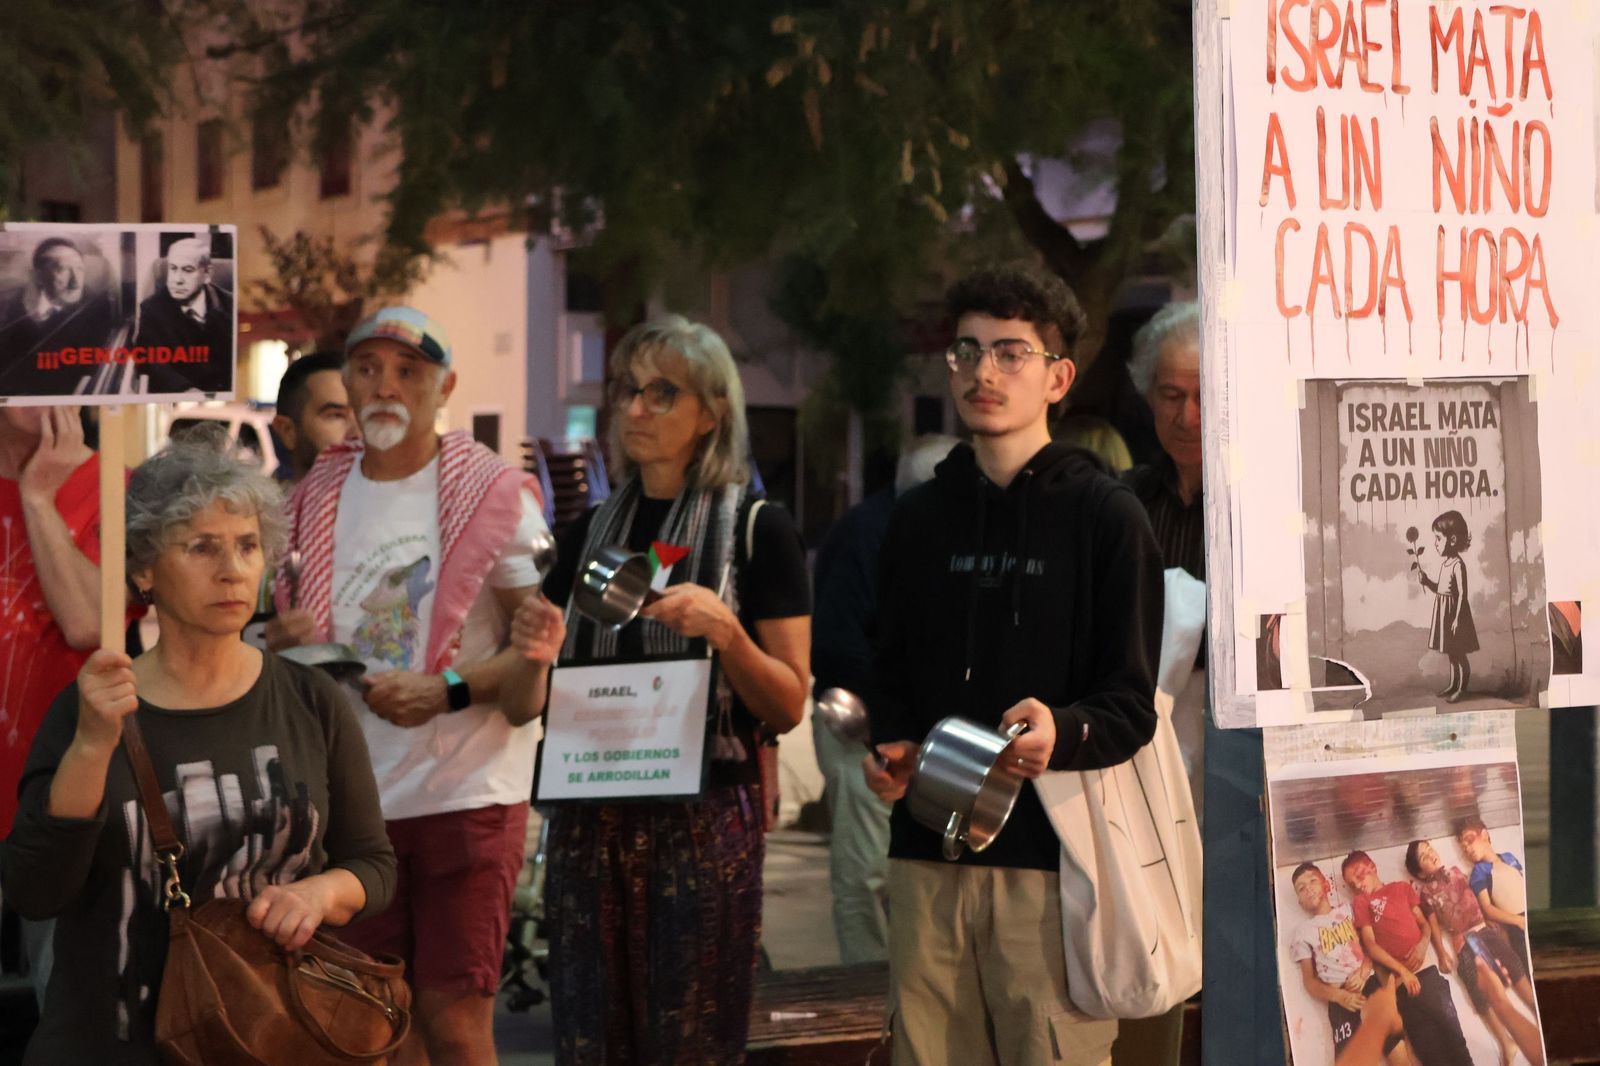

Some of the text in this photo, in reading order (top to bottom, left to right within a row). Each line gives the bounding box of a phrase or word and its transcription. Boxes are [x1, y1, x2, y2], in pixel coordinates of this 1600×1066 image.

[1267, 0, 1553, 102] ISRAEL MATA
[1259, 112, 1297, 211] A
[1317, 105, 1382, 212] UN
[1274, 217, 1560, 330] CADA HORA
[1347, 400, 1498, 433] ISRAEL MATA
[1358, 430, 1478, 469] A UN NIÑO
[1350, 469, 1499, 502] CADA HORA.
[588, 685, 637, 698] ISRAEL,
[562, 748, 680, 763] Y LOS GOBIERNOS
[567, 769, 670, 784] SE ARRODILLAN
